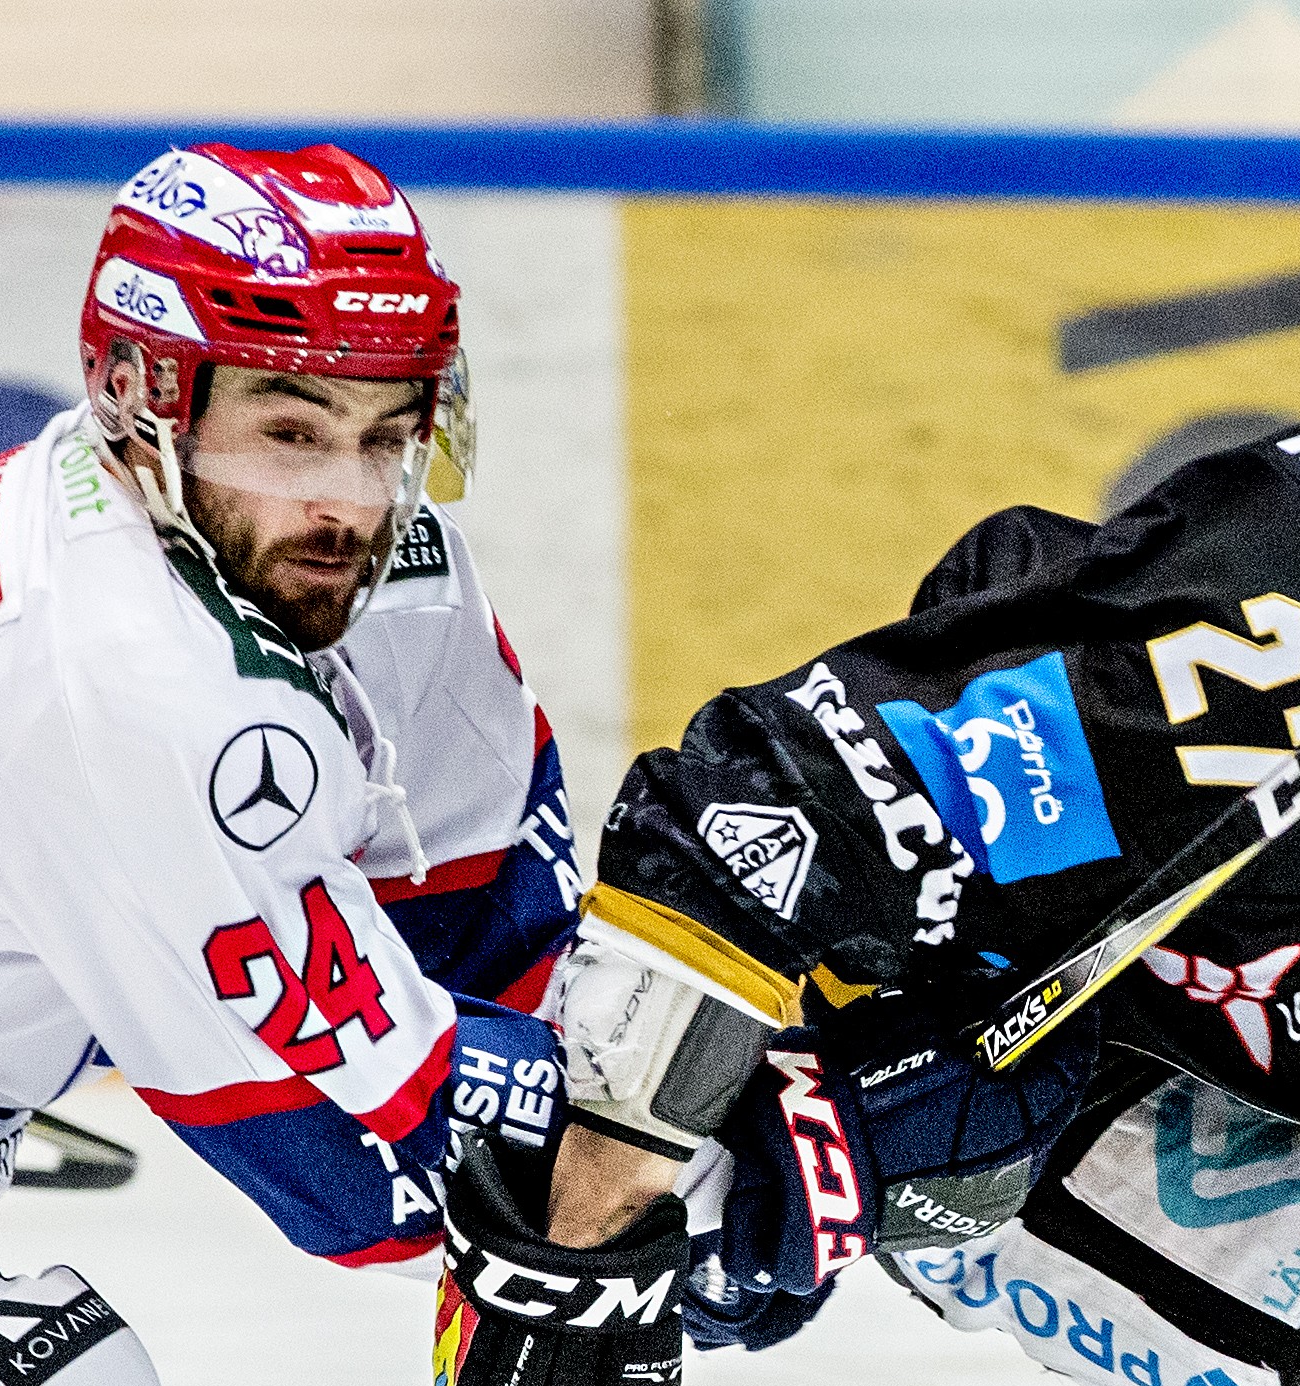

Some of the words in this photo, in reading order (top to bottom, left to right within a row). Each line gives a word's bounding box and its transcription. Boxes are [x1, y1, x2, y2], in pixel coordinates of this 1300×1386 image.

[114, 274, 168, 322] elisa
[332, 291, 430, 314] CCM
[59, 434, 112, 520] oint
[201, 875, 397, 1076] 24
[983, 995, 1047, 1068] TACKS
[1041, 979, 1063, 1005] 2.0
[766, 1049, 867, 1285] CCM
